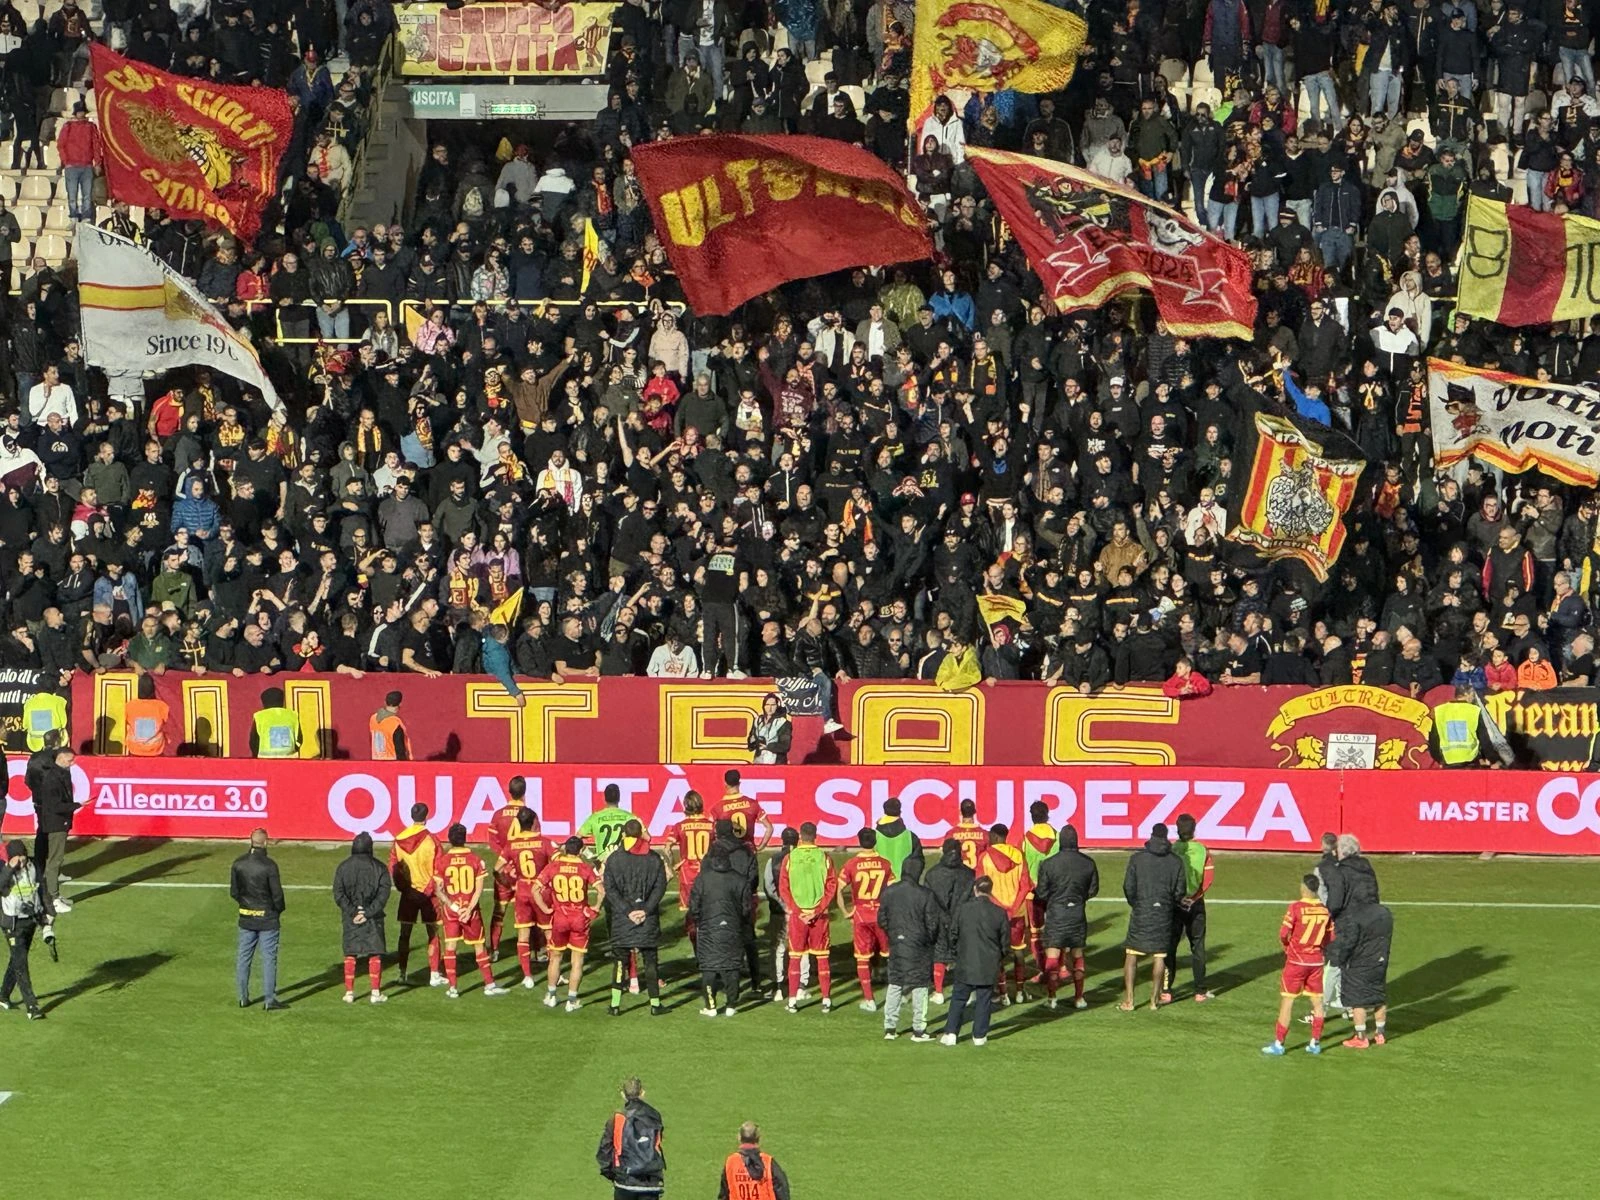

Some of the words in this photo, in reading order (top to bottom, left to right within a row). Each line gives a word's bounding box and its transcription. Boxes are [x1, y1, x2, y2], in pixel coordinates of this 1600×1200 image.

[439, 7, 575, 34] GRUPPO
[437, 34, 580, 71] CAVITA
[413, 91, 455, 106] USCITA
[146, 333, 200, 356] Since
[1306, 688, 1405, 714] ULTRAS
[95, 784, 215, 809] Alleanza
[224, 787, 267, 811] 3.0
[328, 764, 702, 841] QUALITÀ
[814, 778, 1313, 843] SICUREZZA
[1418, 801, 1530, 822] MASTER
[685, 831, 710, 860] 10
[961, 840, 977, 869] 3
[519, 850, 537, 879] 6
[445, 865, 475, 895] 30
[552, 874, 584, 903] 98
[855, 870, 886, 900] 27
[1300, 914, 1329, 946] 77
[739, 1183, 760, 1200] 014
